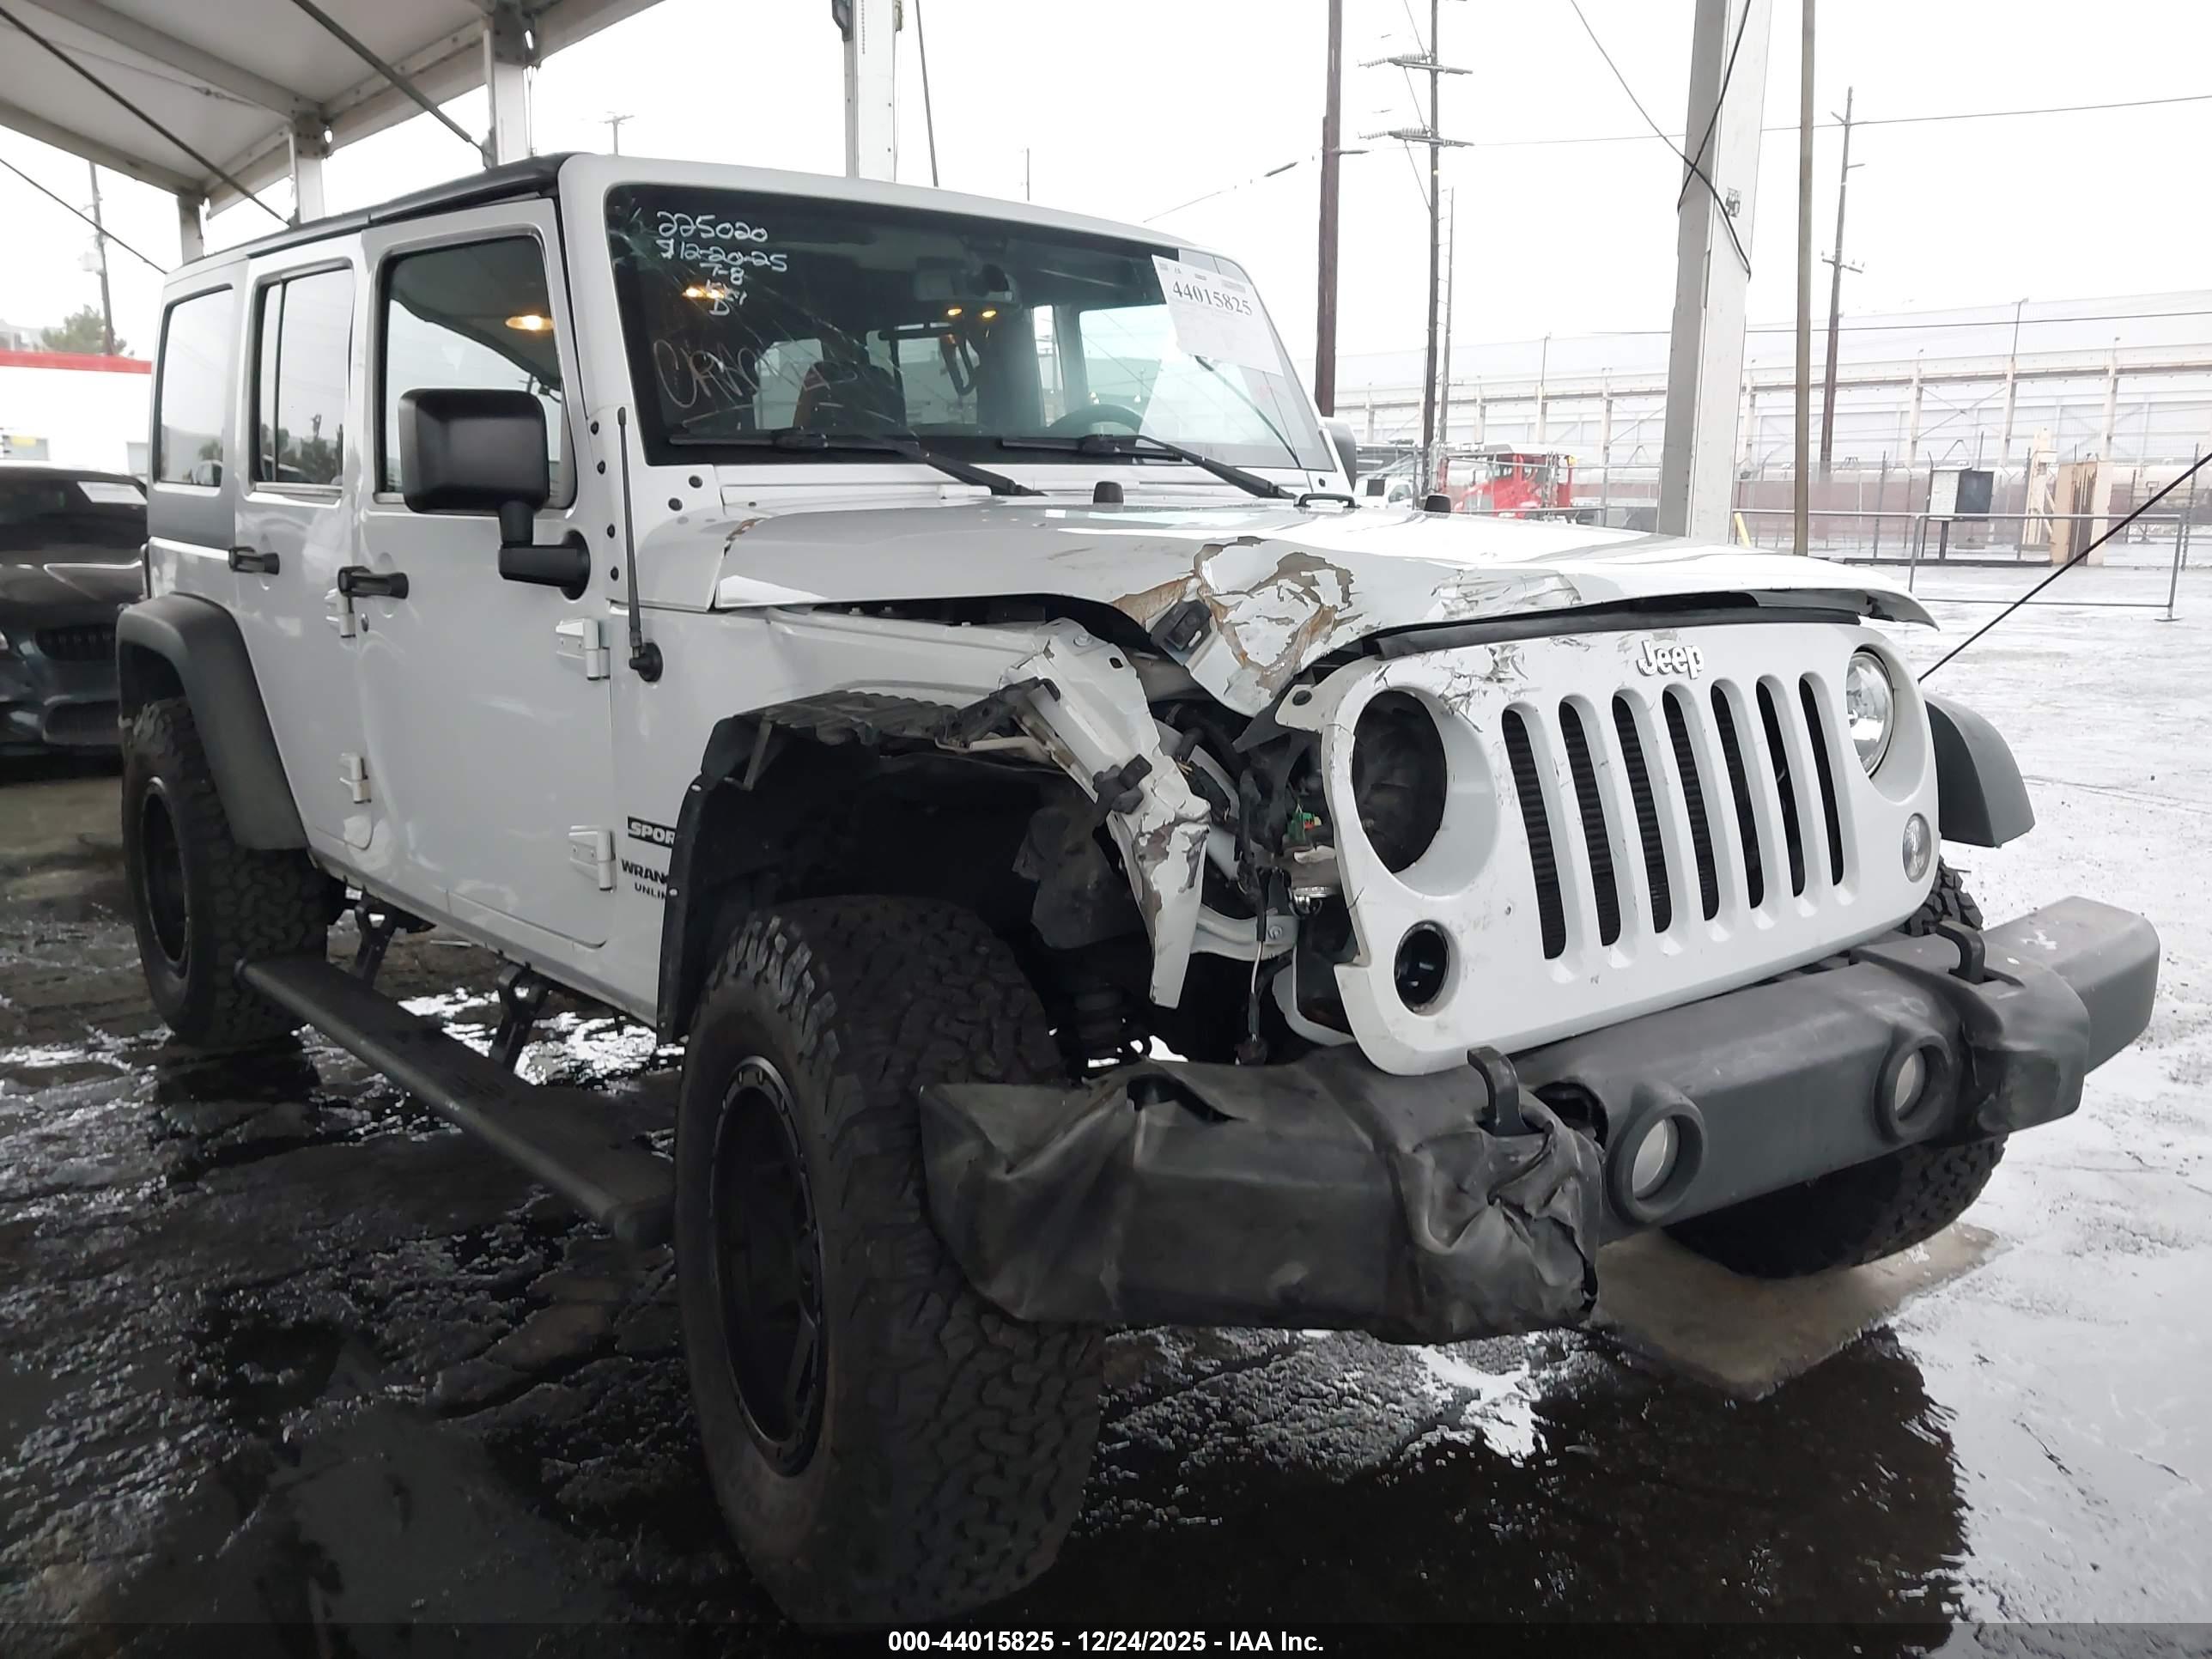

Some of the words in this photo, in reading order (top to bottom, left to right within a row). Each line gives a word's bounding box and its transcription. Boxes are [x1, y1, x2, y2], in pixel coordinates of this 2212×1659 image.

[657, 211, 769, 242] 225020
[1173, 281, 1253, 316] 44015825
[1636, 639, 1705, 680] Jeep
